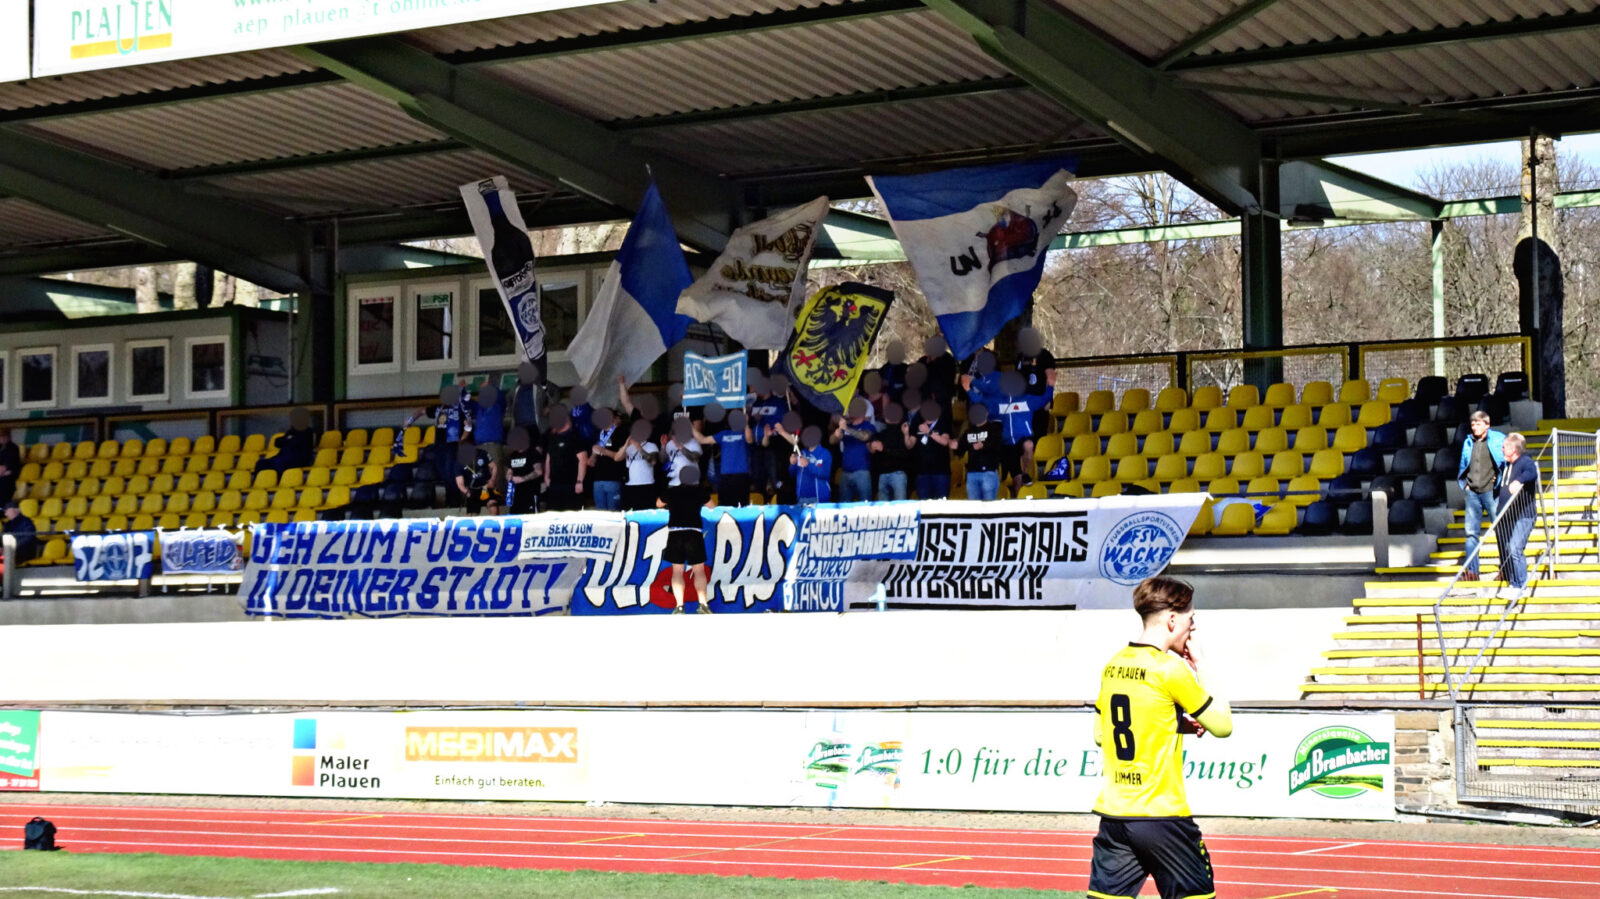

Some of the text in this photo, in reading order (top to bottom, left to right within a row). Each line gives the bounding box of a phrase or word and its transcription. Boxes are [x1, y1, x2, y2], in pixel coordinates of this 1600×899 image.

[721, 361, 743, 393] 90
[251, 518, 523, 565] GEH ZUM FUSSB
[524, 535, 613, 549] STADIONVERBOT
[548, 523, 593, 535] SEKTION
[977, 520, 1089, 563] NIEMALS
[1131, 529, 1160, 543] FSV
[809, 529, 919, 558] NORDHAUSEN
[285, 567, 418, 612] DEINER
[416, 562, 569, 610] STADT!
[1117, 666, 1147, 680] PLAUEN
[1111, 694, 1135, 761] 8
[407, 731, 575, 757] MEDIMAX
[321, 755, 370, 770] Maler
[921, 748, 962, 775] 1:0
[971, 746, 1016, 783] für
[1023, 748, 1068, 777] die
[1290, 744, 1388, 790] Bad Brambacher
[321, 774, 381, 789] Plauen
[435, 775, 545, 789] Einfach gut beraten.
[1115, 771, 1142, 785] LIMMER
